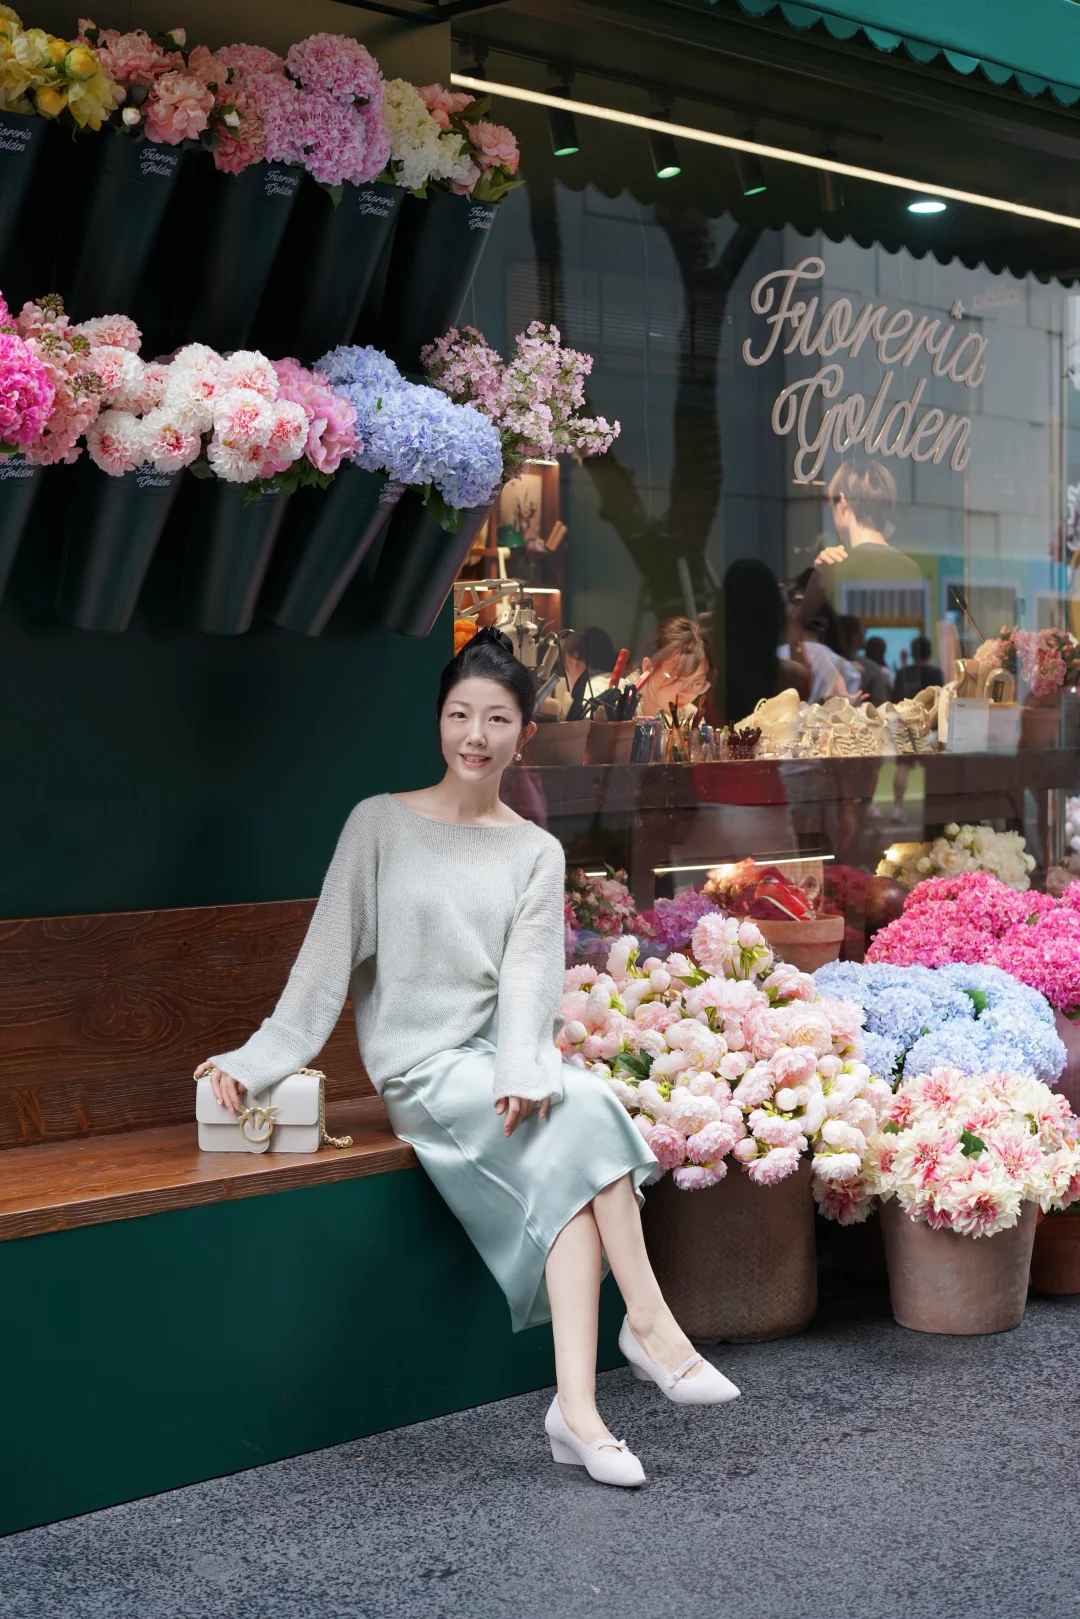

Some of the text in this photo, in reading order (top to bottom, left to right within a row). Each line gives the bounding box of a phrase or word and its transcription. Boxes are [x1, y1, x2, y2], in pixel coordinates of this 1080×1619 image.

[139, 147, 179, 166] Fioreria
[140, 160, 172, 177] Golden
[264, 182, 294, 197] Golden
[359, 202, 390, 218] Golden
[742, 256, 989, 388] Fioreria
[771, 363, 972, 482] Golden
[136, 475, 171, 488] Golden
